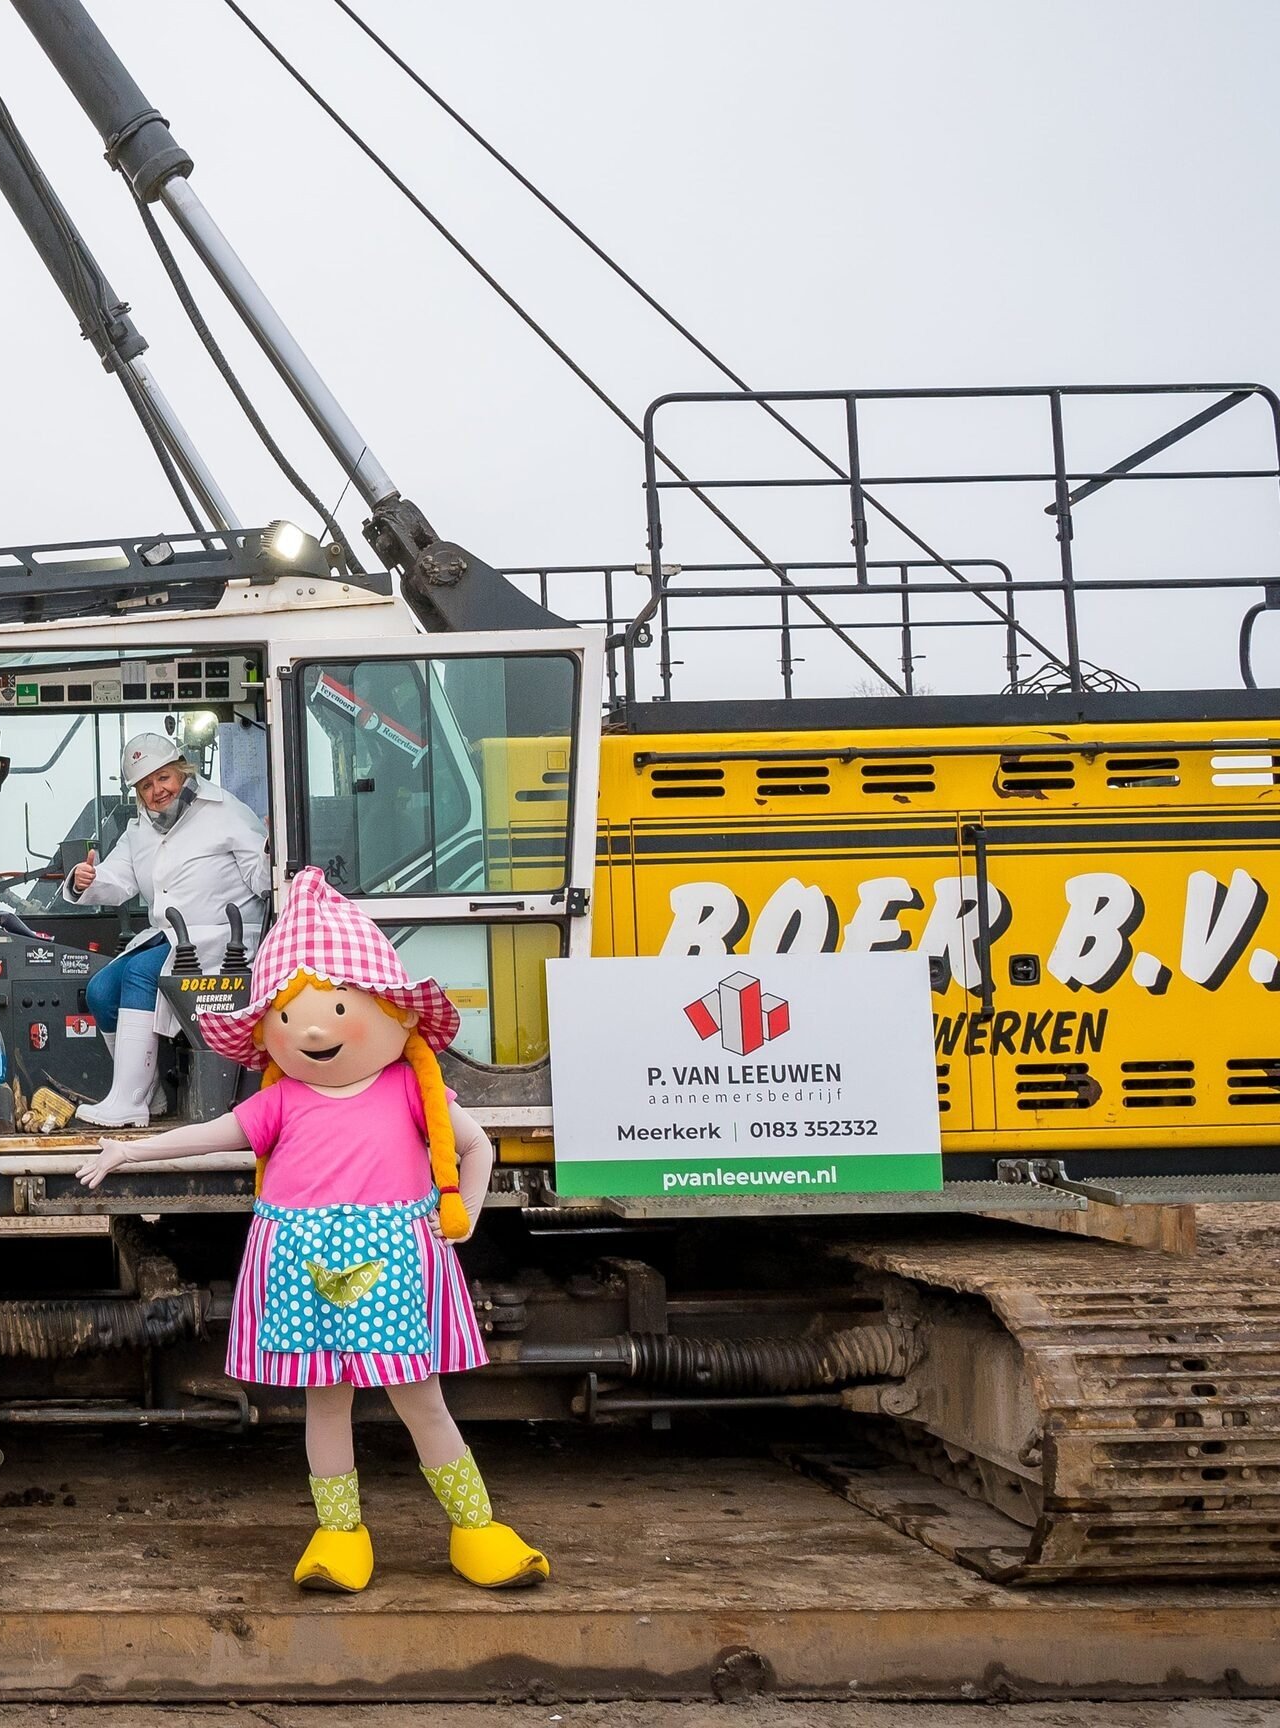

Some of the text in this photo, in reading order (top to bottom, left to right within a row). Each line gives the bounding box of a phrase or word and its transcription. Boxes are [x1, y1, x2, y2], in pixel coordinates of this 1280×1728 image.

[320, 684, 419, 754] Feyenoord Rotterdam
[658, 868, 1280, 994] BOER B.V.
[180, 977, 245, 992] BOER B.V.
[196, 994, 233, 1002] MEERKERK
[933, 1009, 1108, 1055] WERKEN
[647, 1063, 842, 1086] P. VAN LEEUWEN
[648, 1088, 842, 1105] aannemersbedrijf
[617, 1119, 879, 1141] Meerkerk 0183 352332
[663, 1165, 837, 1191] pvanleeuwen.nl
